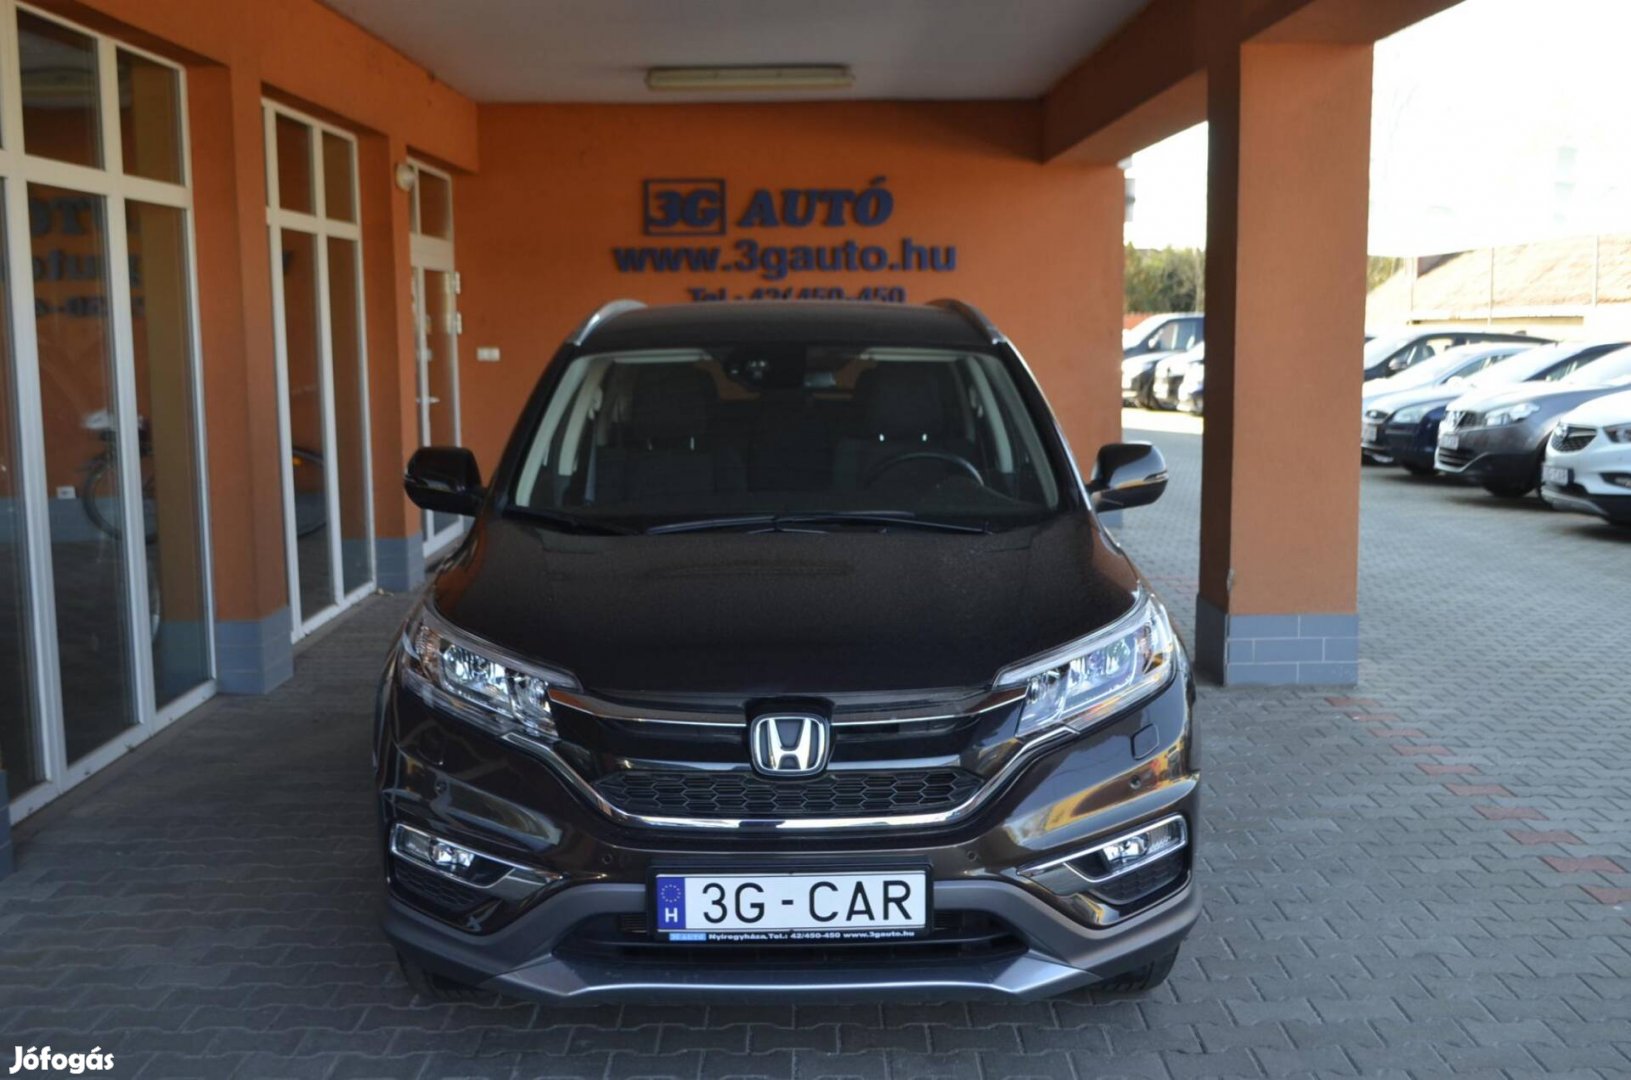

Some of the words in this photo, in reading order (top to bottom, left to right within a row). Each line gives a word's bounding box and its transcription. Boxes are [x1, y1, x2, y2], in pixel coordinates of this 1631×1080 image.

[645, 189, 722, 227] 3G
[737, 177, 893, 228] AUTÓ
[612, 238, 956, 280] www.3gauto.hu
[665, 907, 679, 922] H
